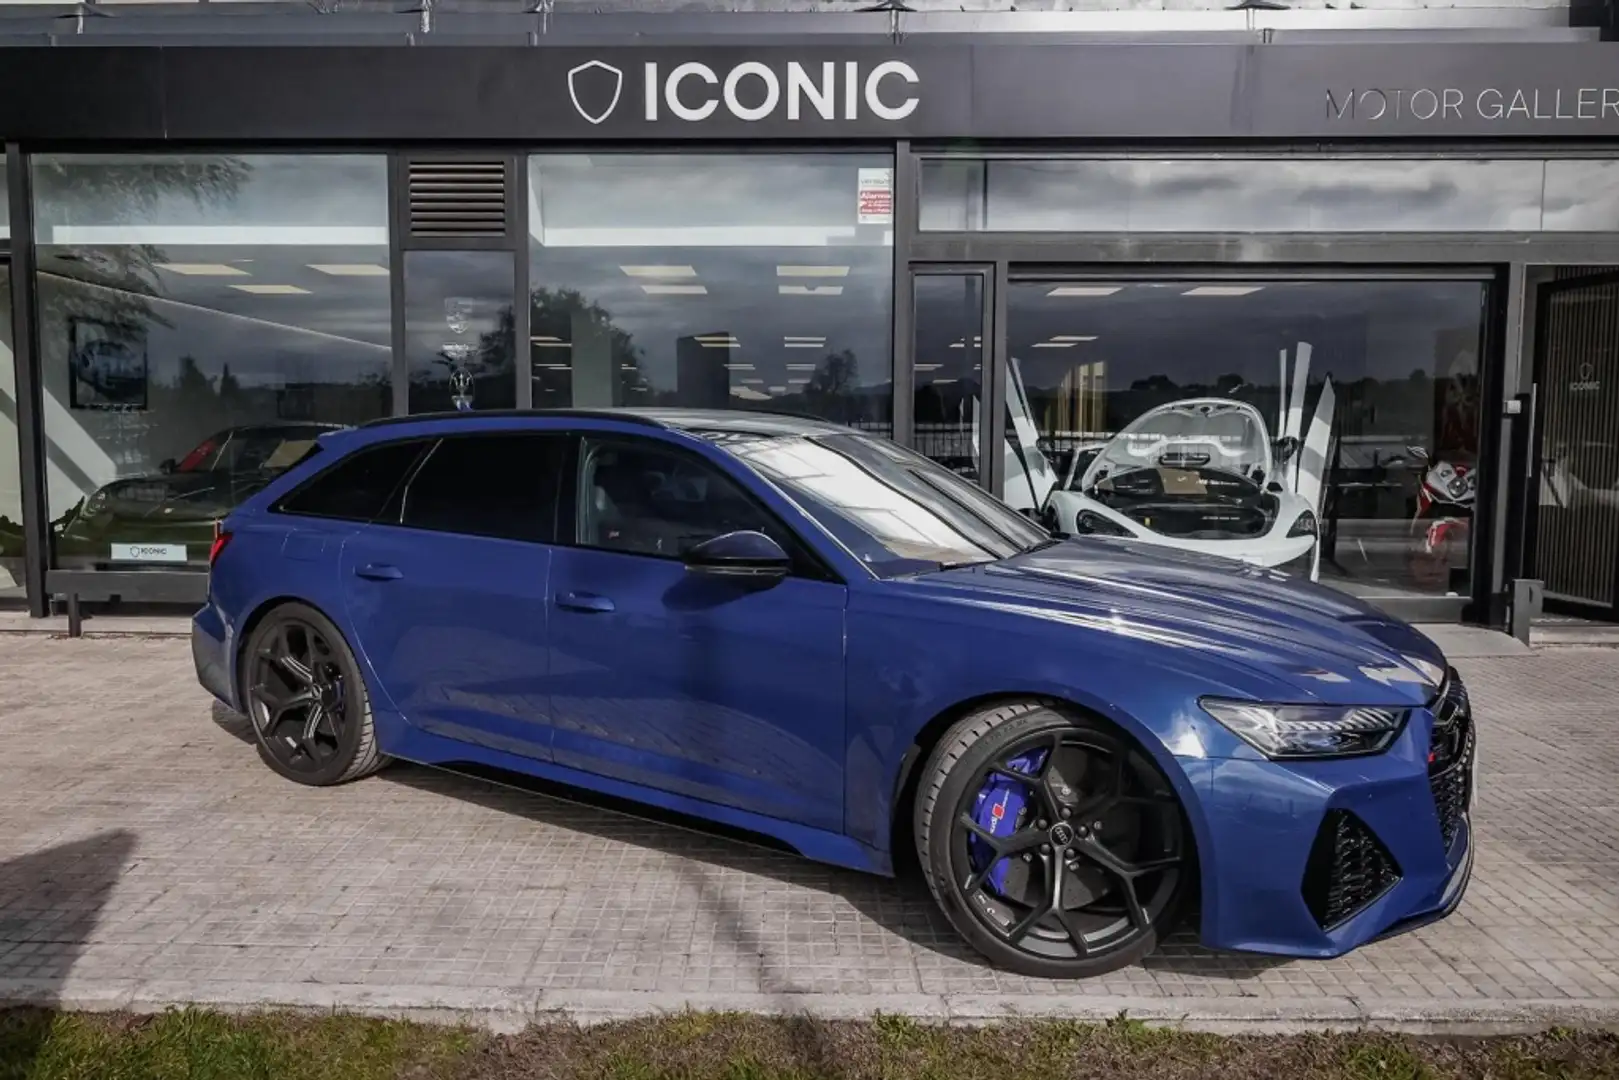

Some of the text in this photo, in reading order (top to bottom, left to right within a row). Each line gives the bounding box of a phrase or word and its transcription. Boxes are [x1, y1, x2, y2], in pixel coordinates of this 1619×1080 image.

[644, 60, 920, 121] ICONIC
[1326, 88, 1619, 120] MOTOR GALLER
